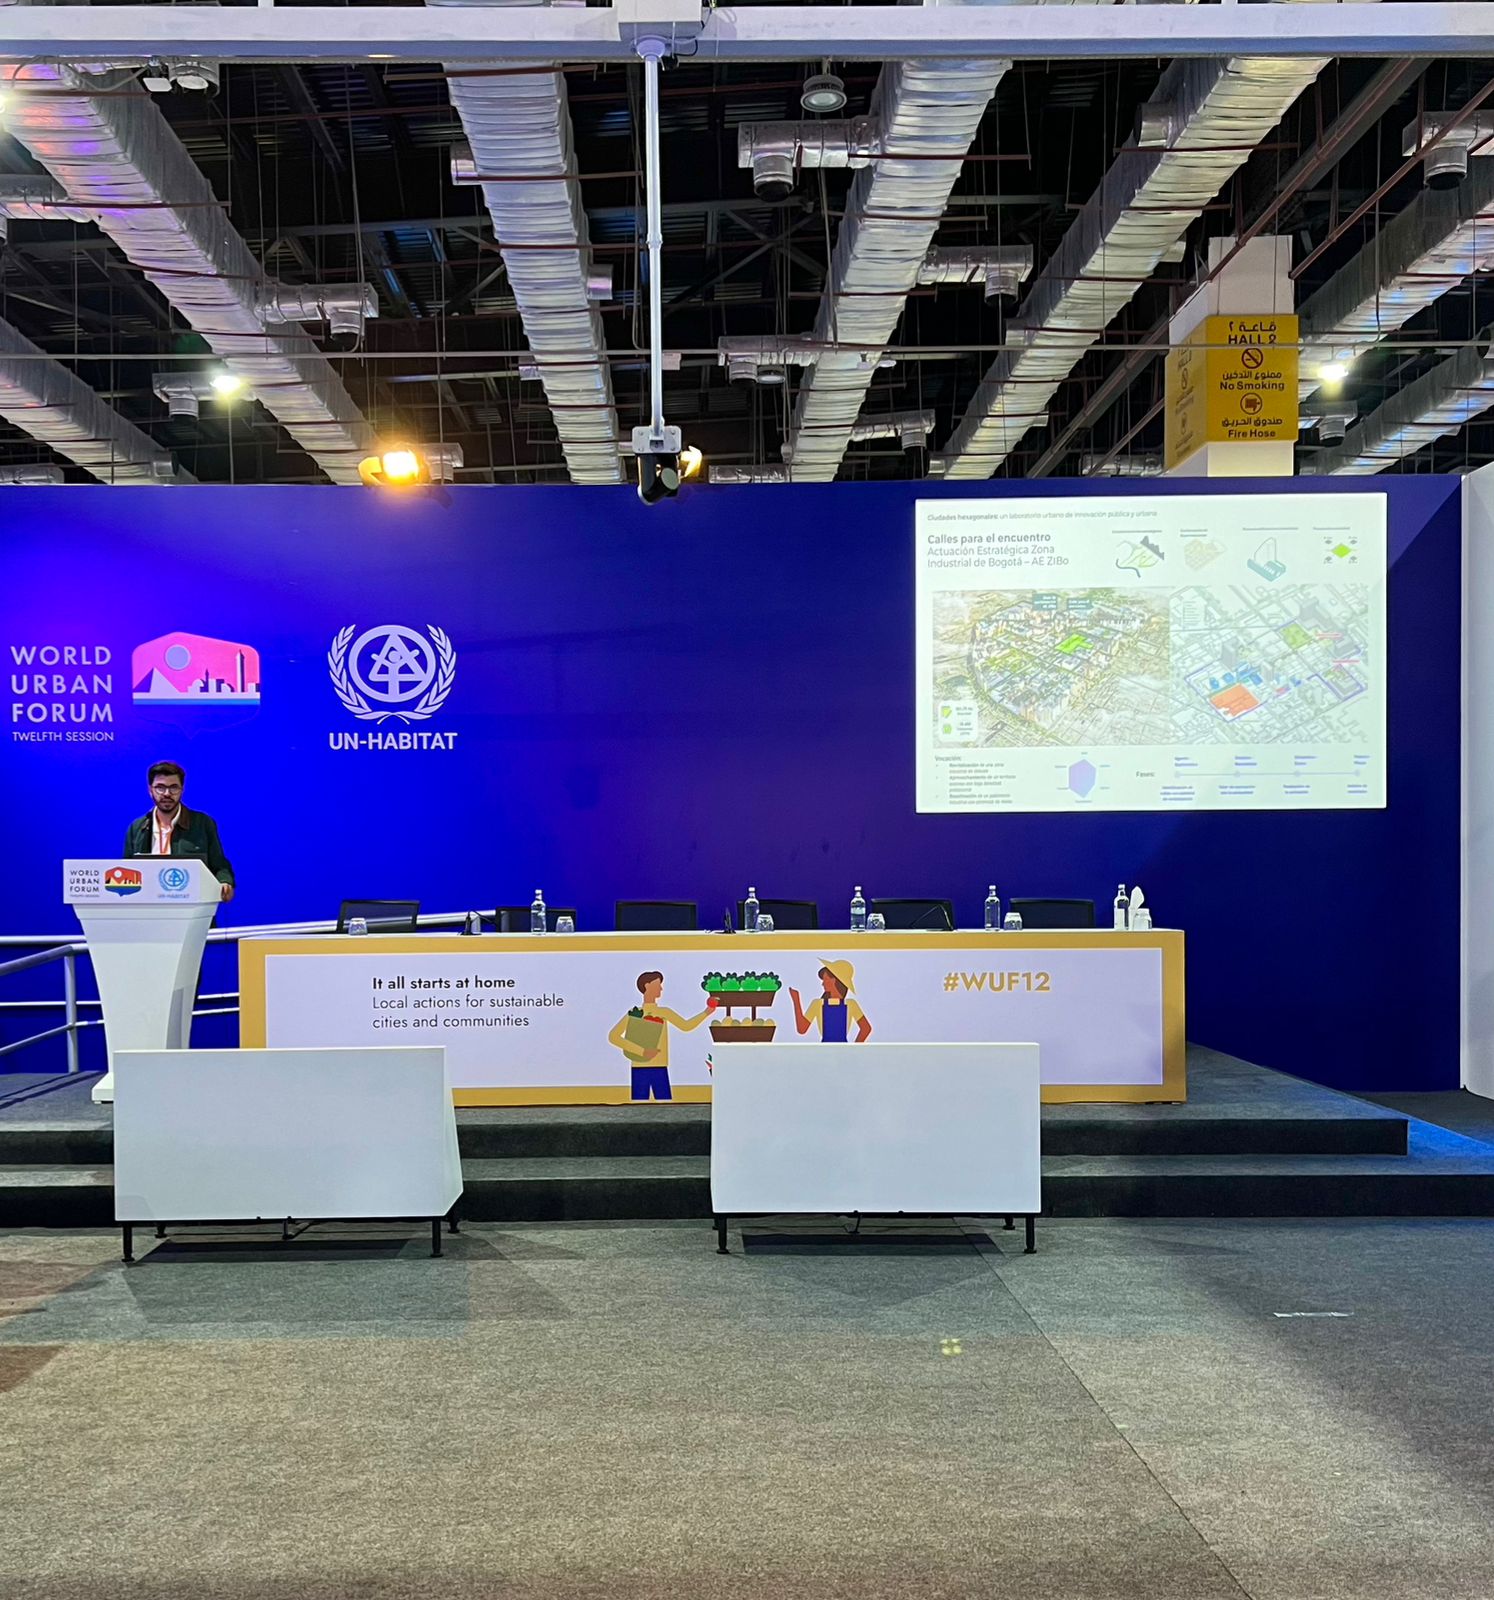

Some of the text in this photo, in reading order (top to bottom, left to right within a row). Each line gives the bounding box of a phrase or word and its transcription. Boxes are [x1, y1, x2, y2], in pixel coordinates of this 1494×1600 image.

[1239, 321, 1277, 332] قاعة
[1228, 334, 1277, 345] HALL 2
[1222, 371, 1282, 381] ممنوع التدخين
[1220, 382, 1285, 392] No Smoking
[1228, 429, 1276, 438] Fire Hose
[927, 533, 1051, 546] Calles para el encuentro
[927, 545, 1055, 558] Actuación Estratégica Zona
[927, 557, 972, 568] Industrial
[973, 557, 986, 567] de
[988, 556, 1023, 568] Bogotá
[1031, 556, 1044, 566] AE
[10, 645, 112, 666] WORLD
[11, 674, 112, 695] URBAN
[12, 702, 113, 723] FORUM
[12, 731, 114, 742] TWELFTH SESSION
[329, 732, 458, 750] UN-HABITAT
[373, 975, 516, 989] It all starts at home
[943, 971, 1051, 992] #WUF12
[373, 993, 564, 1009] Local actions for sustainable
[372, 1014, 530, 1029] cities and communities
